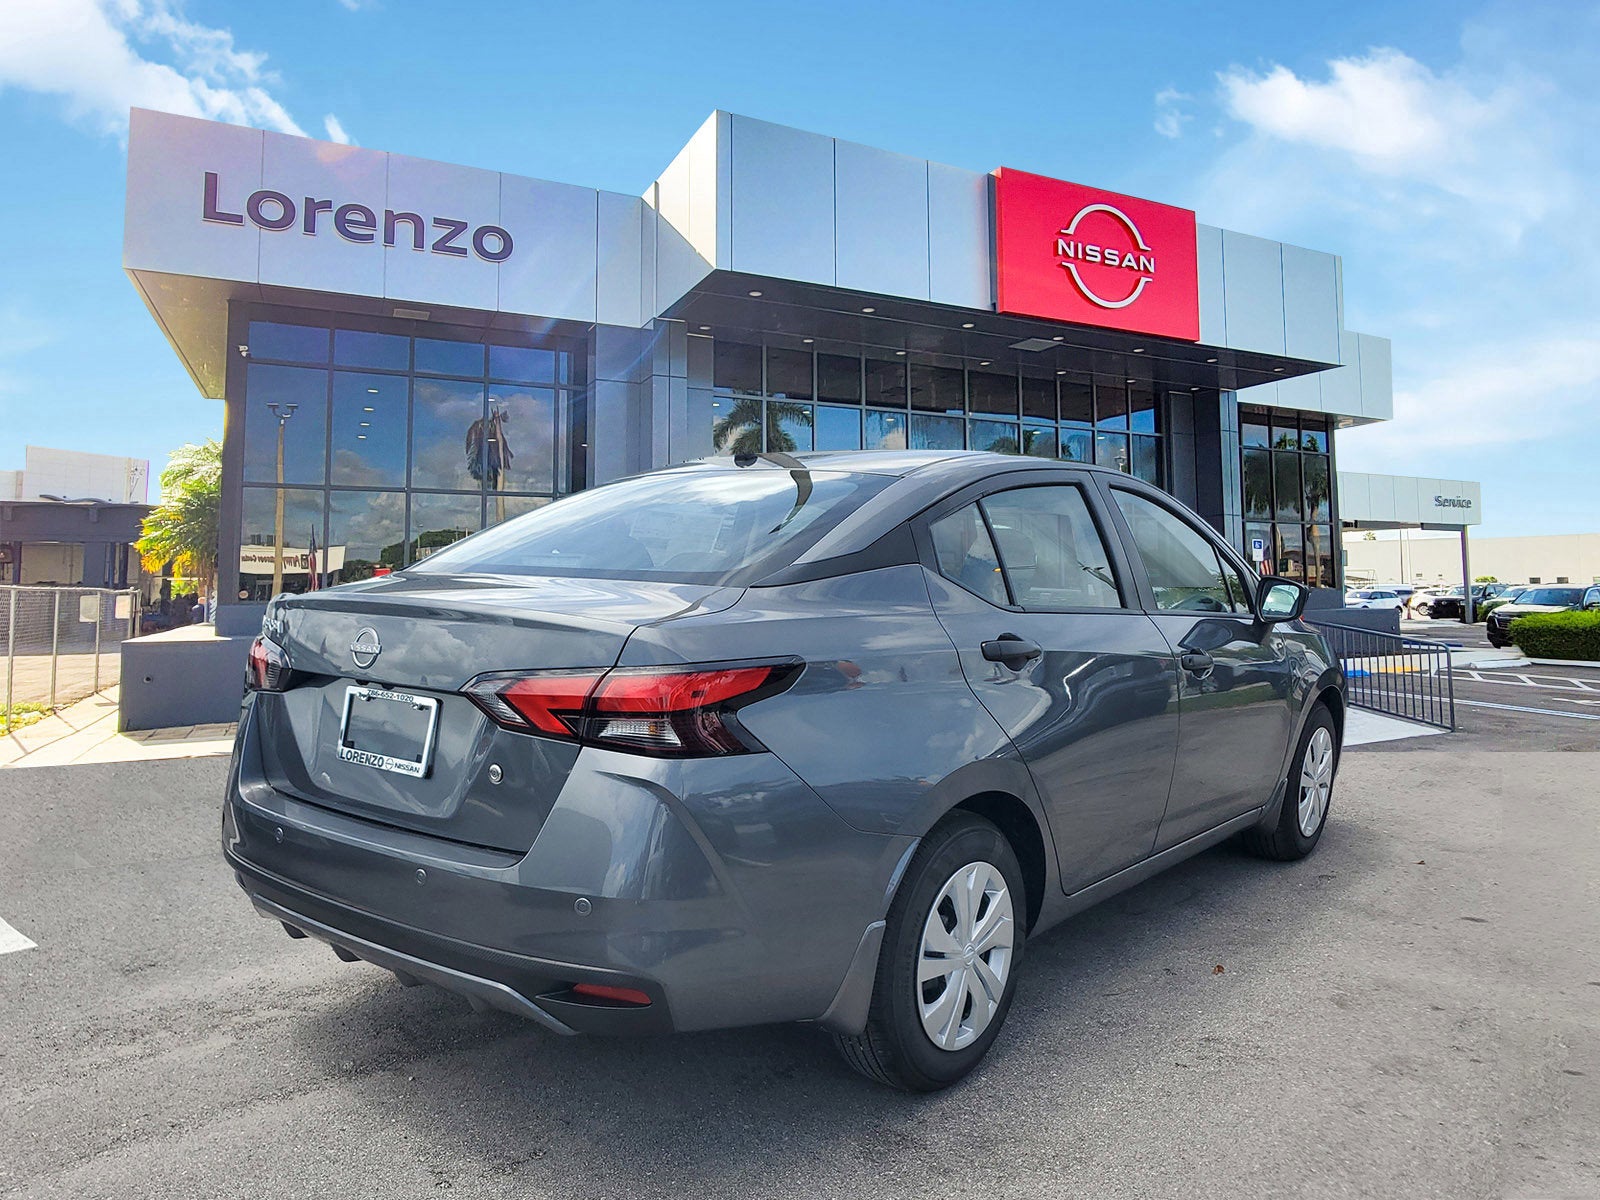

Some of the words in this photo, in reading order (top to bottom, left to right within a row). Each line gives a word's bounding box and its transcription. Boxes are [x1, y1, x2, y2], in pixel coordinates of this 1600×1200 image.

[202, 171, 514, 262] Lorenzo
[1057, 238, 1155, 273] NISSAN
[1434, 495, 1472, 509] Service
[367, 689, 414, 703] 786-652-1020
[340, 748, 385, 768] LORENZO
[394, 762, 421, 773] NISSAN
